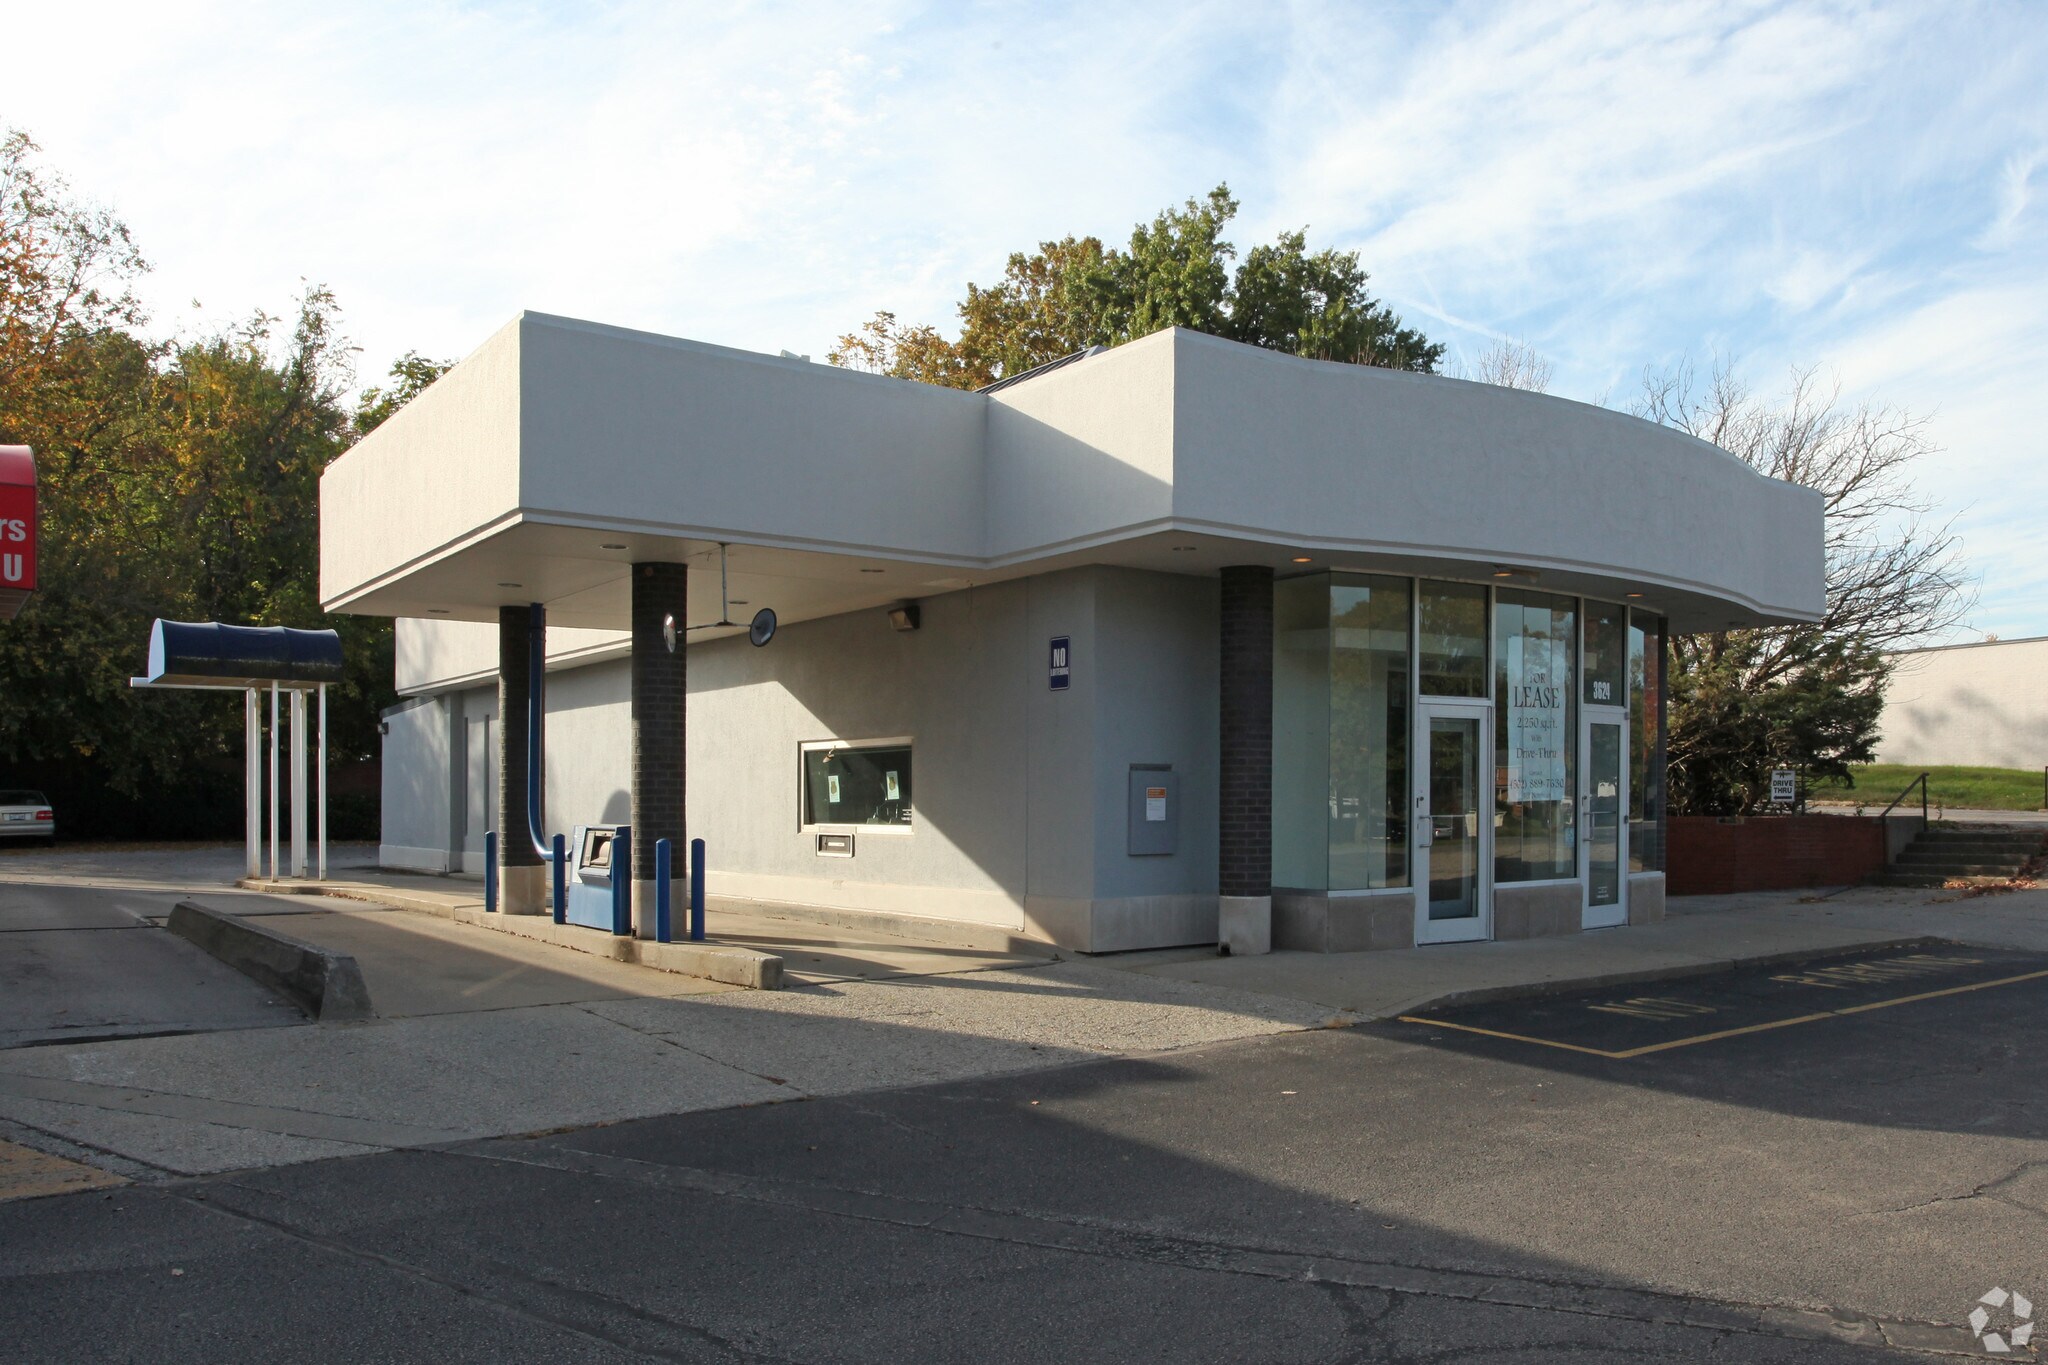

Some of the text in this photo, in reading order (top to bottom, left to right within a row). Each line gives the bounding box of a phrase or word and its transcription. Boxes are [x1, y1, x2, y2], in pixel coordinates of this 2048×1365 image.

[1053, 648, 1066, 667] NO
[1514, 686, 1560, 708] LEASE
[1593, 681, 1610, 699] 3624
[1516, 747, 1557, 759] Drive-Thru
